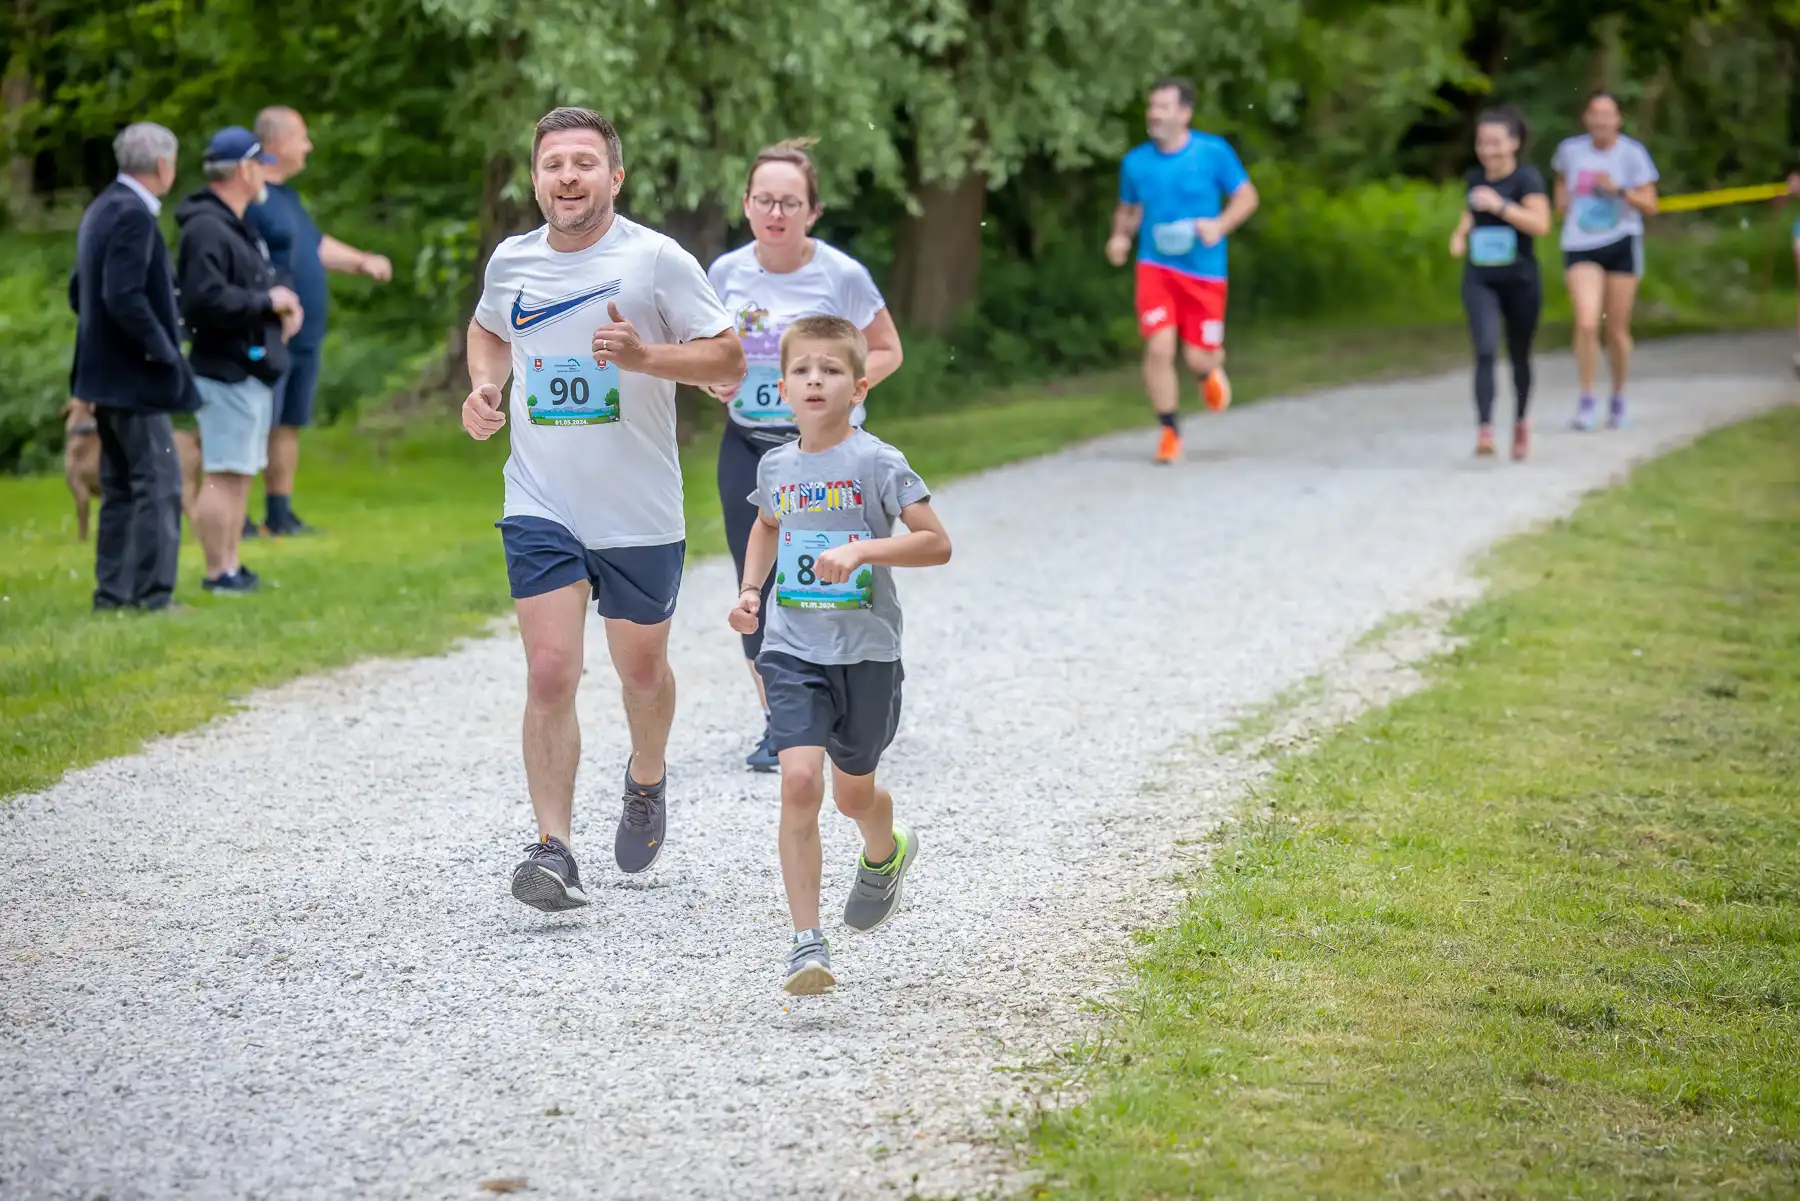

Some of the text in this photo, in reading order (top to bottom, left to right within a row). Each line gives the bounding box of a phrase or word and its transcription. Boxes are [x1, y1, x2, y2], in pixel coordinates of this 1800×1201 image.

[549, 376, 590, 406] 90
[554, 418, 589, 426] 01.05.2024.
[797, 554, 832, 586] 8
